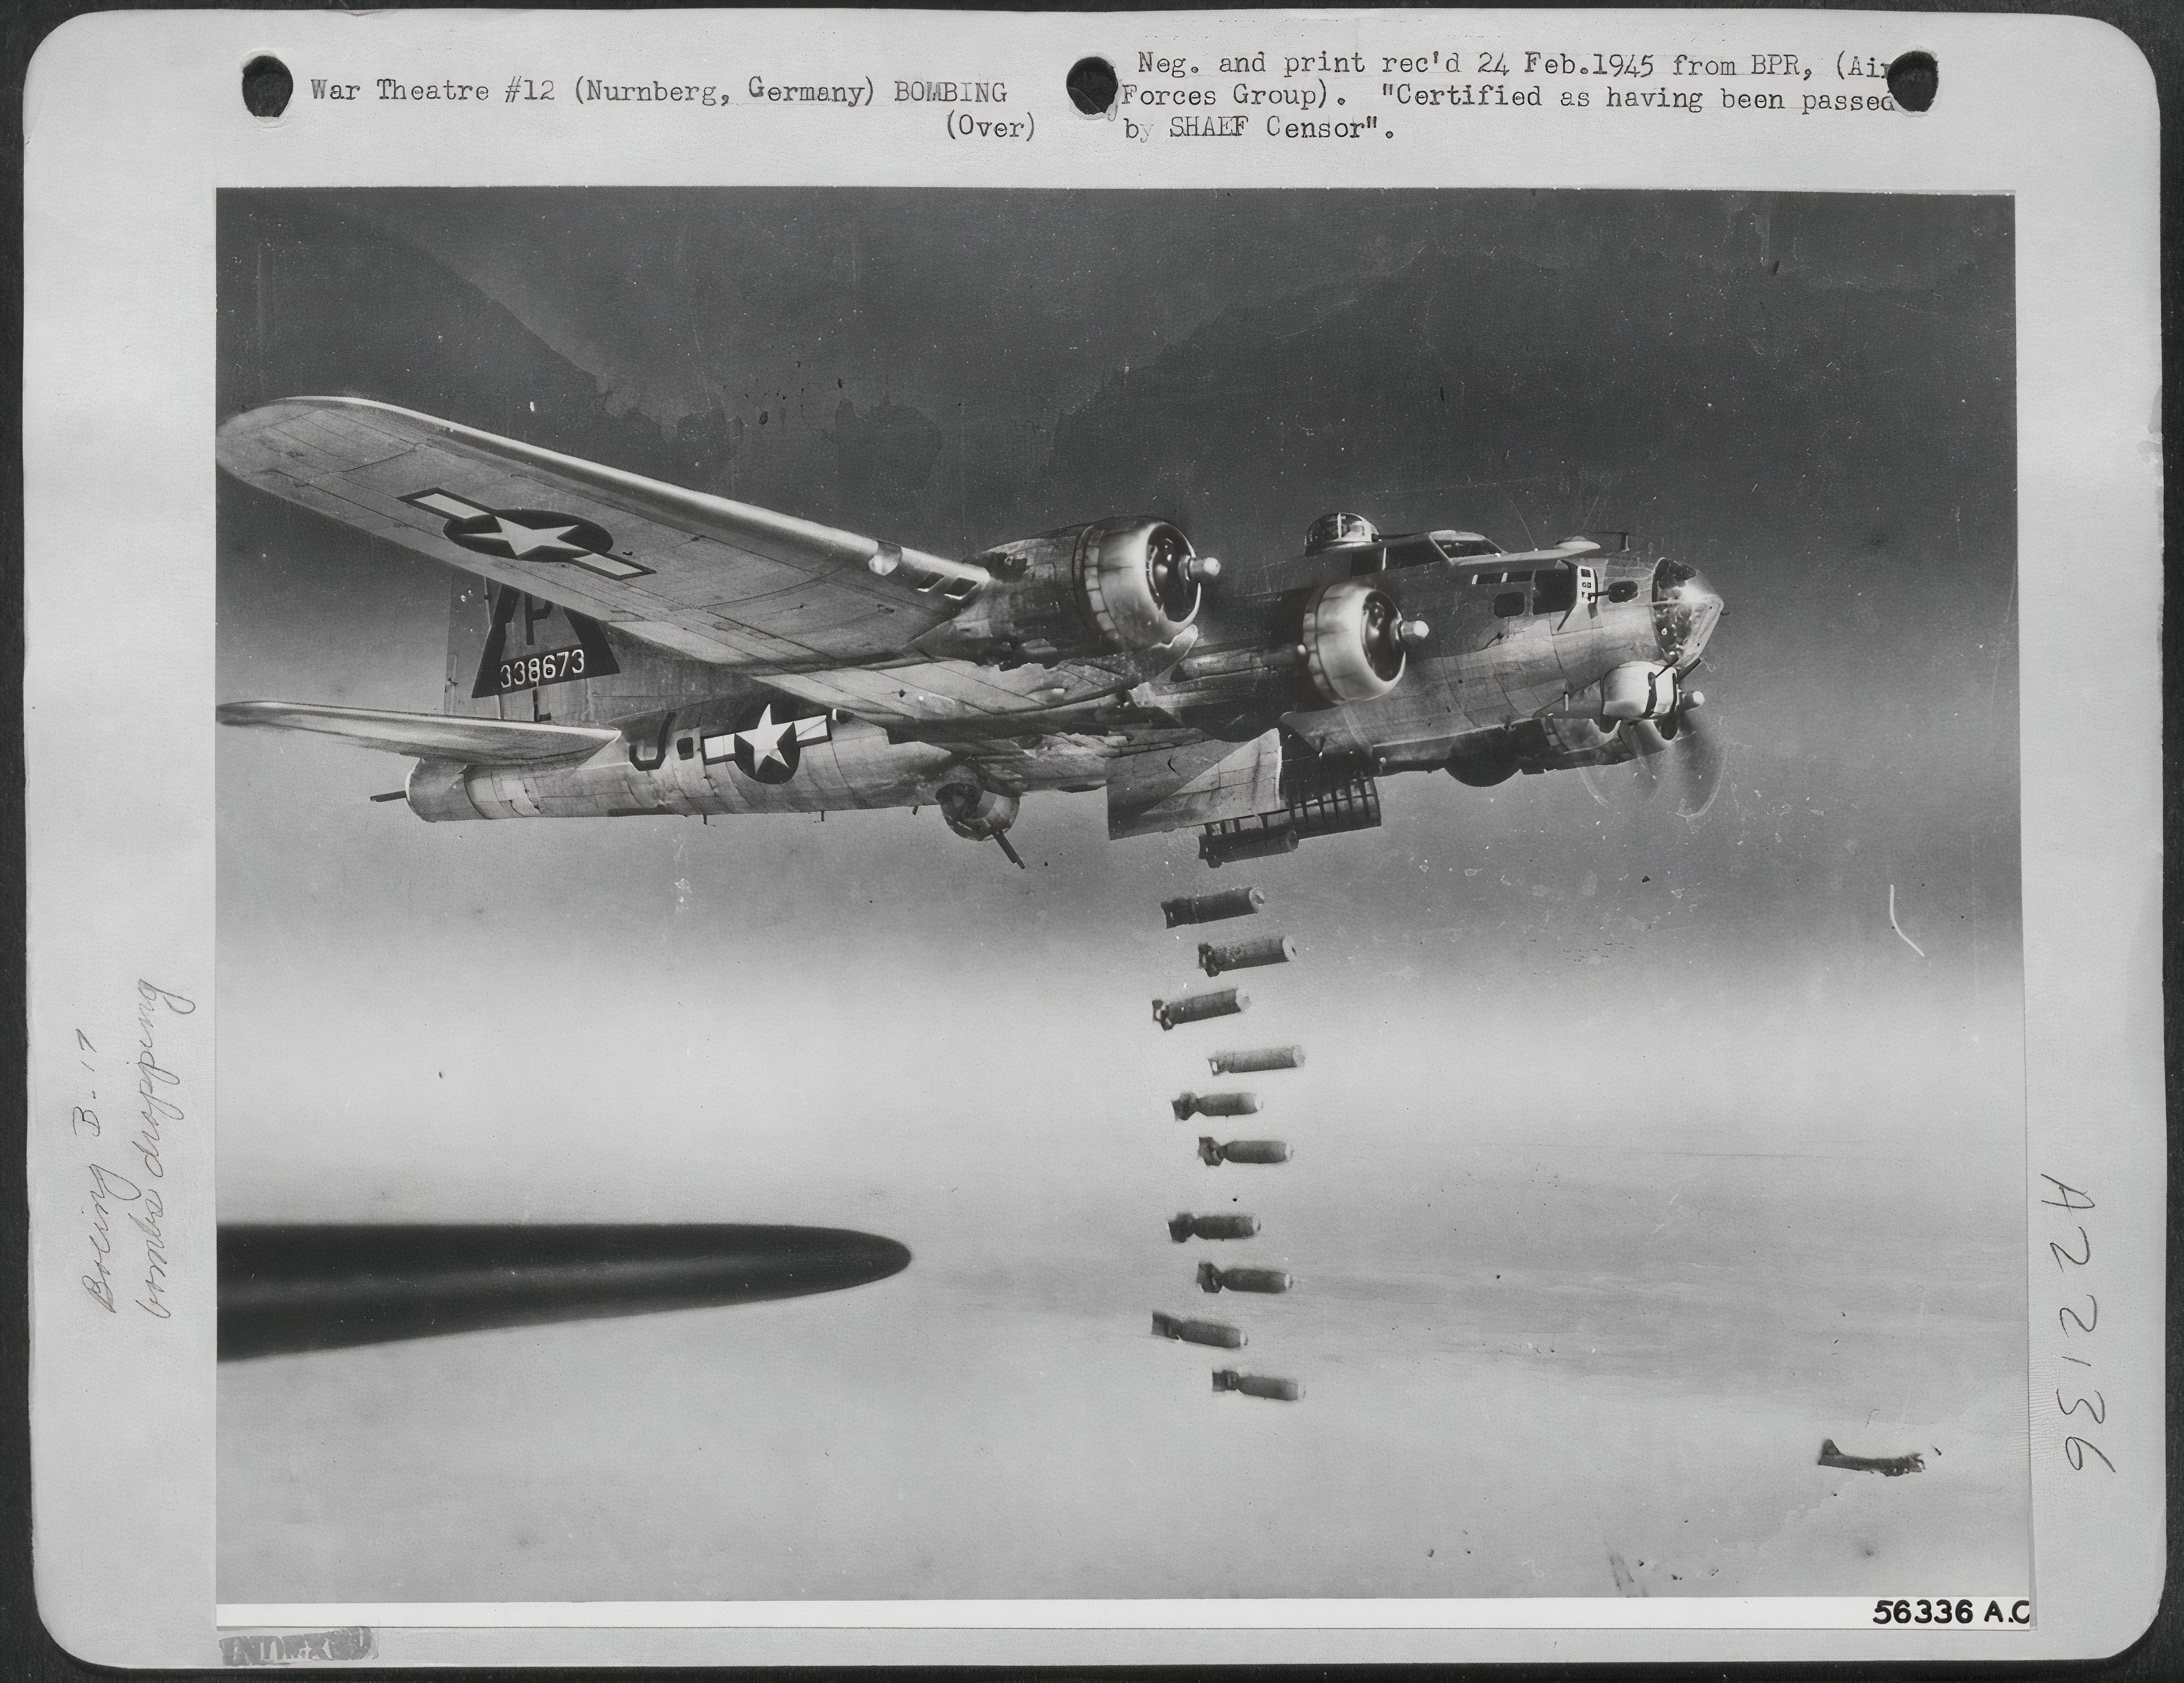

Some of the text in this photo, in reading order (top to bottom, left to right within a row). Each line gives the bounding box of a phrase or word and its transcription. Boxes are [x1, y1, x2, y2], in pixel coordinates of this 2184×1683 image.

[1138, 51, 1199, 78] Neg.
[1219, 51, 1266, 73] and
[1284, 51, 1365, 78] print
[1382, 51, 1460, 73] rec'd
[1478, 52, 1509, 76] 24
[1524, 51, 1653, 78] Feb.1945
[1673, 53, 1736, 76] from
[1753, 54, 1812, 79] BPR,
[311, 76, 1007, 107] War Theatre #12 (Nurnberg, Germany) BOMBING
[1122, 84, 1216, 105] Forces
[1234, 79, 1346, 110] Group).
[1383, 83, 1542, 106] "Certified
[1560, 92, 1589, 107] as
[1606, 86, 1703, 113] having
[1720, 88, 1785, 109] been
[947, 111, 1035, 142] (Over)
[1123, 115, 1393, 143] by SHAEF Censor".
[500, 649, 585, 688] 338673
[128, 978, 196, 1319] bombs dropping
[82, 1163, 141, 1314] Boeing
[2041, 1174, 2117, 1474] A22136
[1872, 1599, 1973, 1624] 56336
